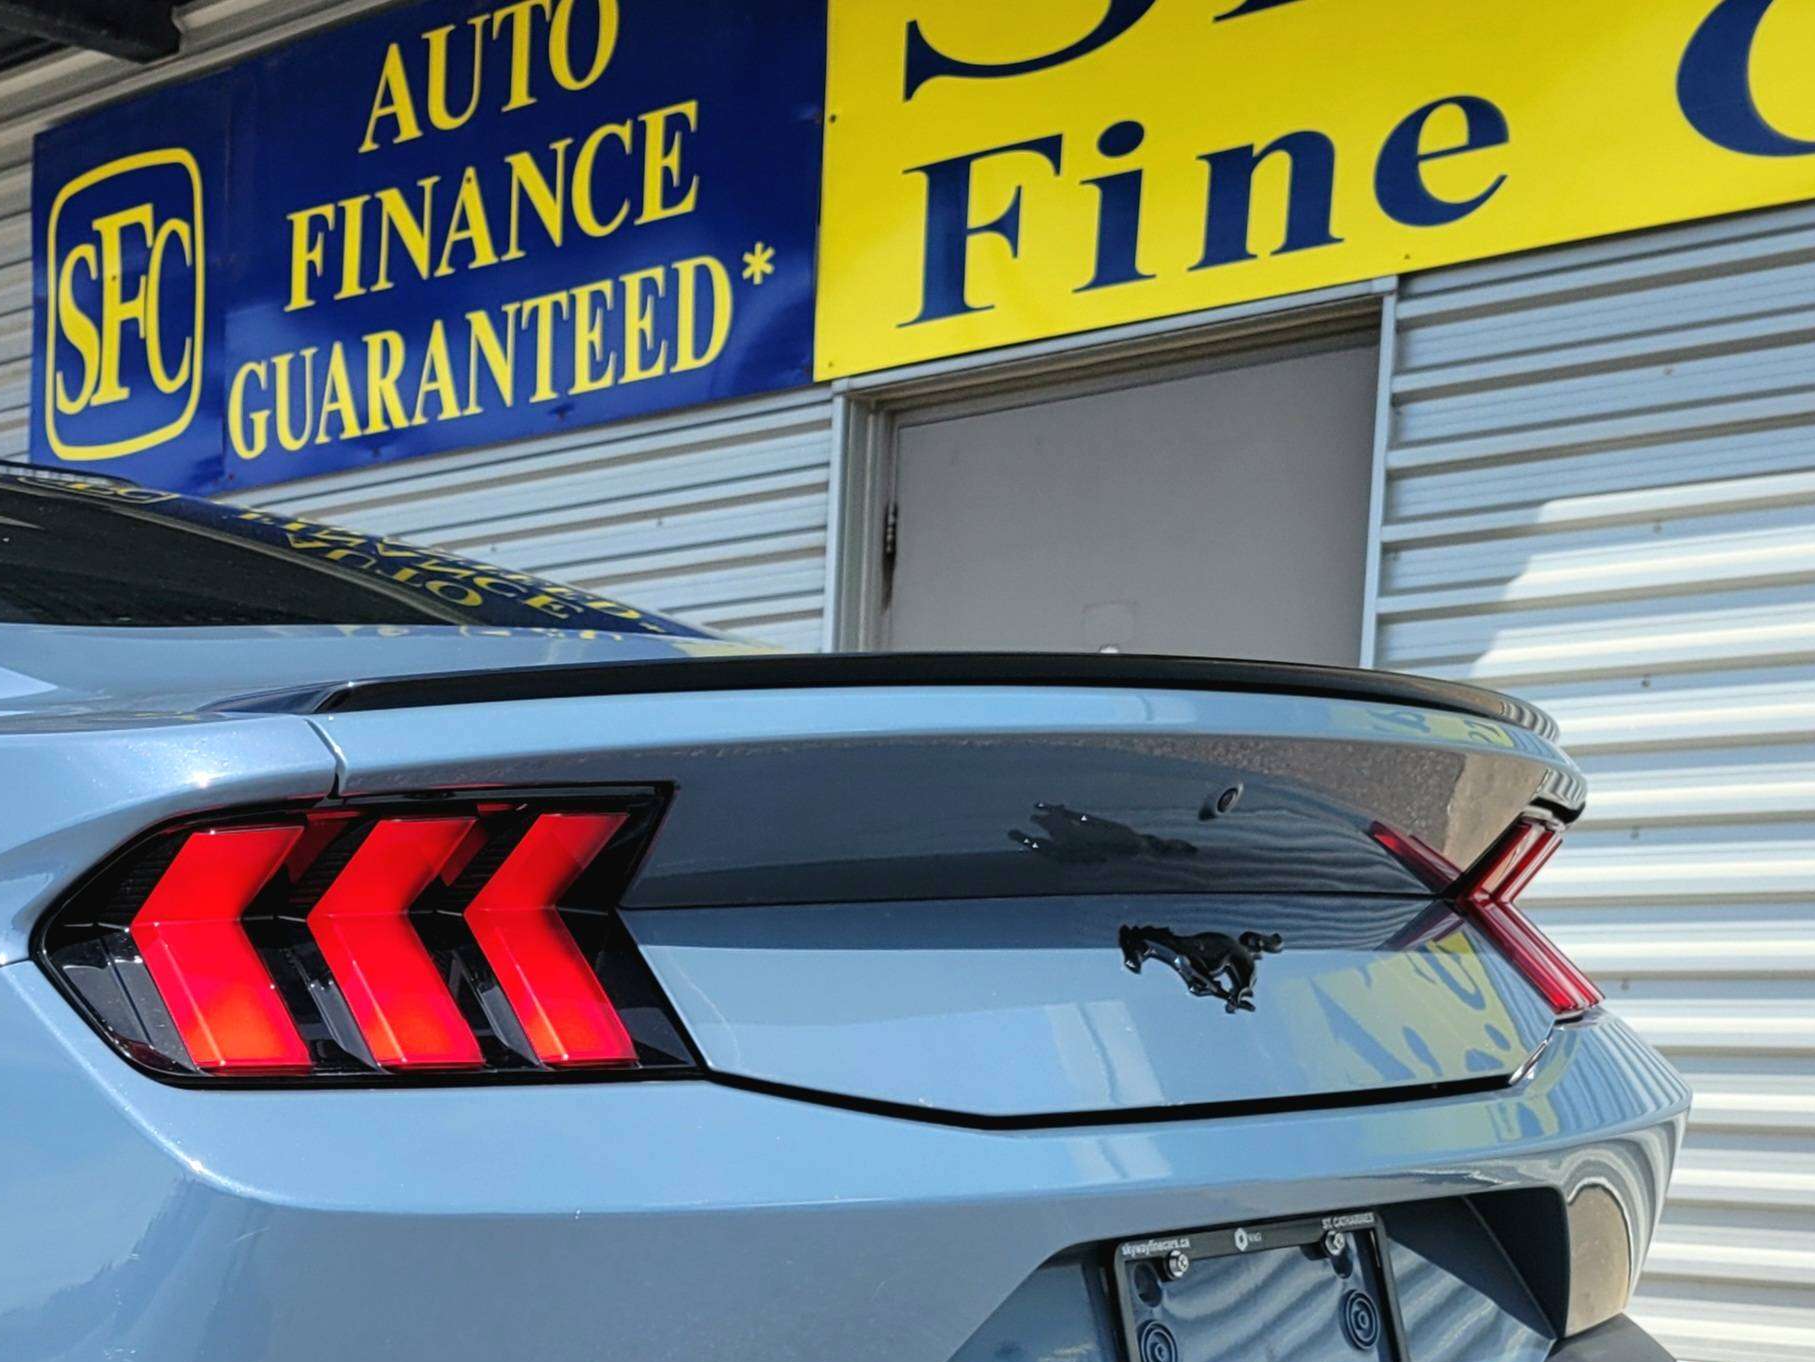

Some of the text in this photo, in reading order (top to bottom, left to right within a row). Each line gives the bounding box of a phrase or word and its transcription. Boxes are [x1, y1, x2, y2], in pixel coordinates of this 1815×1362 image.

[359, 0, 620, 153] AUTO
[55, 202, 193, 416] SFC
[284, 100, 700, 313] FINANCE
[895, 94, 1510, 327] Fine
